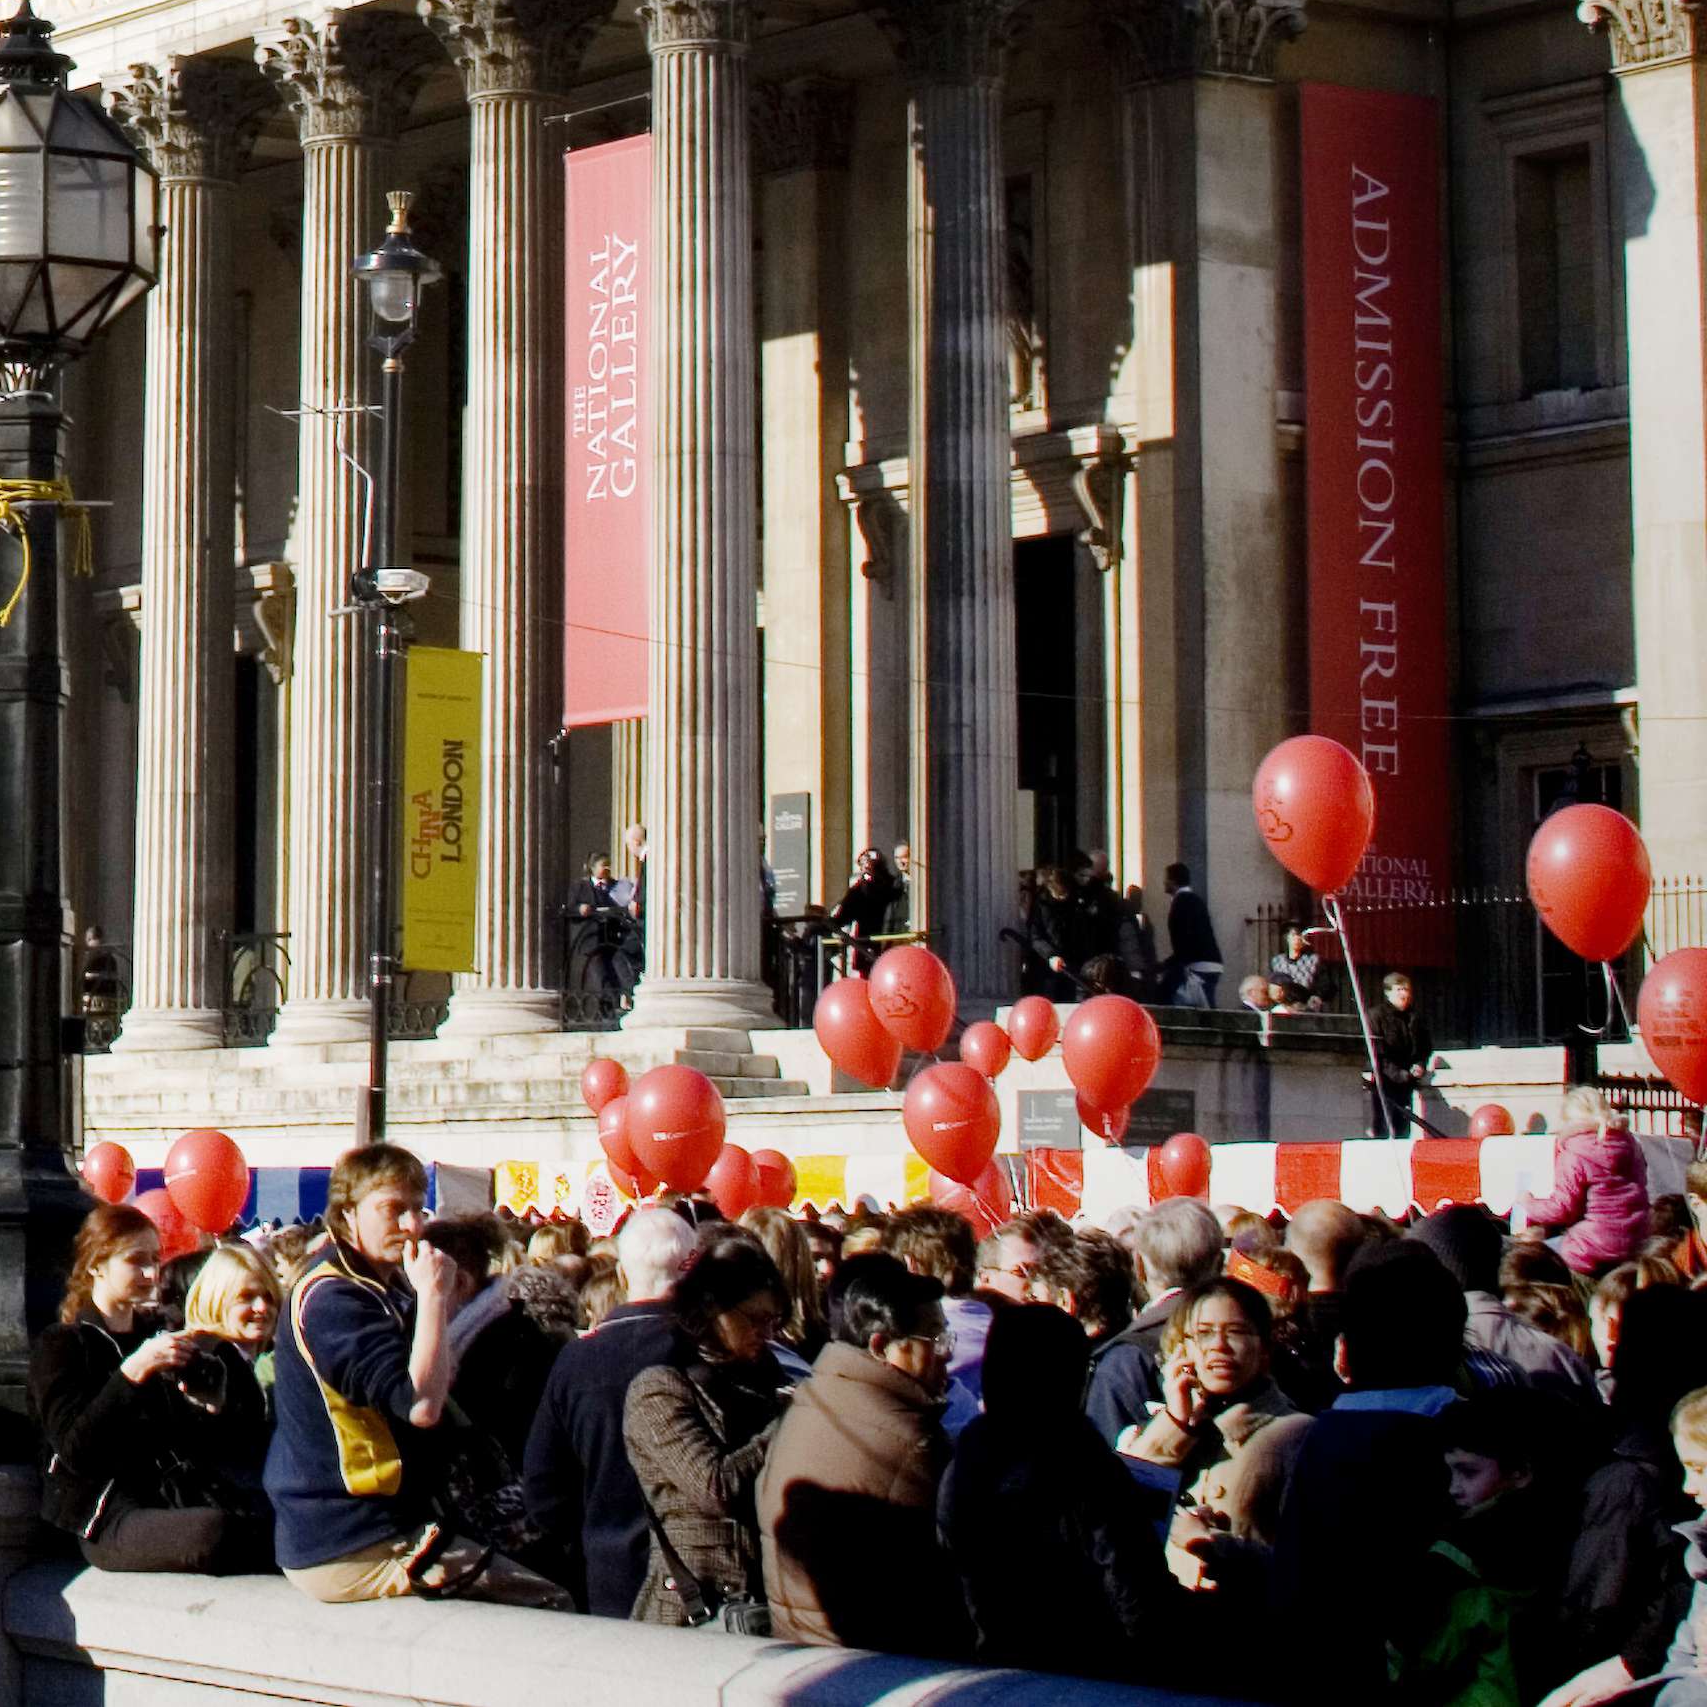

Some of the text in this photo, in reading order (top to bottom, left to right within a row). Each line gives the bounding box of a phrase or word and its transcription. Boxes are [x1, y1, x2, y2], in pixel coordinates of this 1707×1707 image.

[573, 385, 586, 437] THE
[587, 234, 610, 503] NATIONAL
[610, 231, 637, 499] GALLERY
[1351, 163, 1400, 776] ADMISSION FREE
[441, 739, 464, 863] LONDON
[1358, 855, 1431, 877] TIONAL
